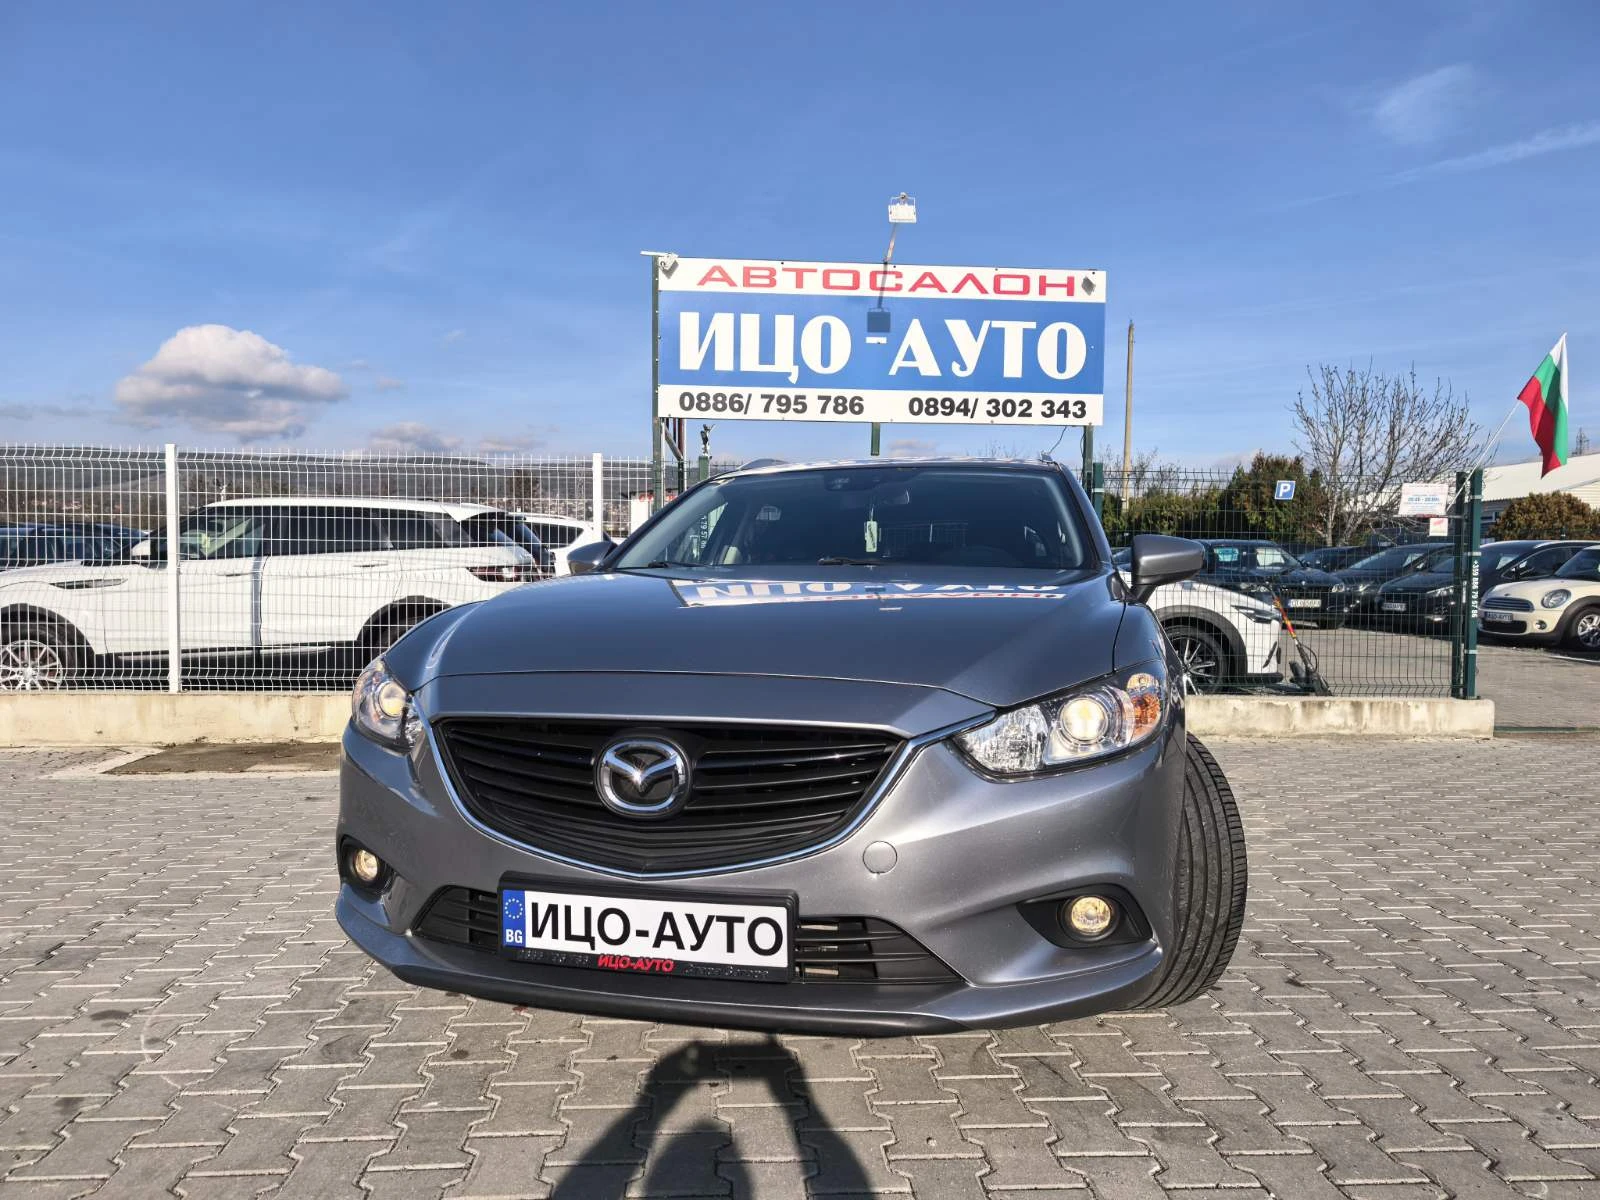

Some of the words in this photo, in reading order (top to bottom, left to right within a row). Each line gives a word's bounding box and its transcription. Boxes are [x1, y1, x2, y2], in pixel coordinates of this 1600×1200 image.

[697, 265, 1075, 297] АВТОСАЛОН
[679, 391, 752, 415] 0886/
[760, 394, 808, 414] 795
[817, 395, 865, 415] 786
[908, 397, 979, 419] 0894/
[986, 399, 1033, 418] 302
[1040, 400, 1087, 419] 343
[505, 929, 523, 944] BG
[531, 902, 784, 956] ИЦО-АУТО
[597, 954, 676, 973] ИЦО-АУТО
